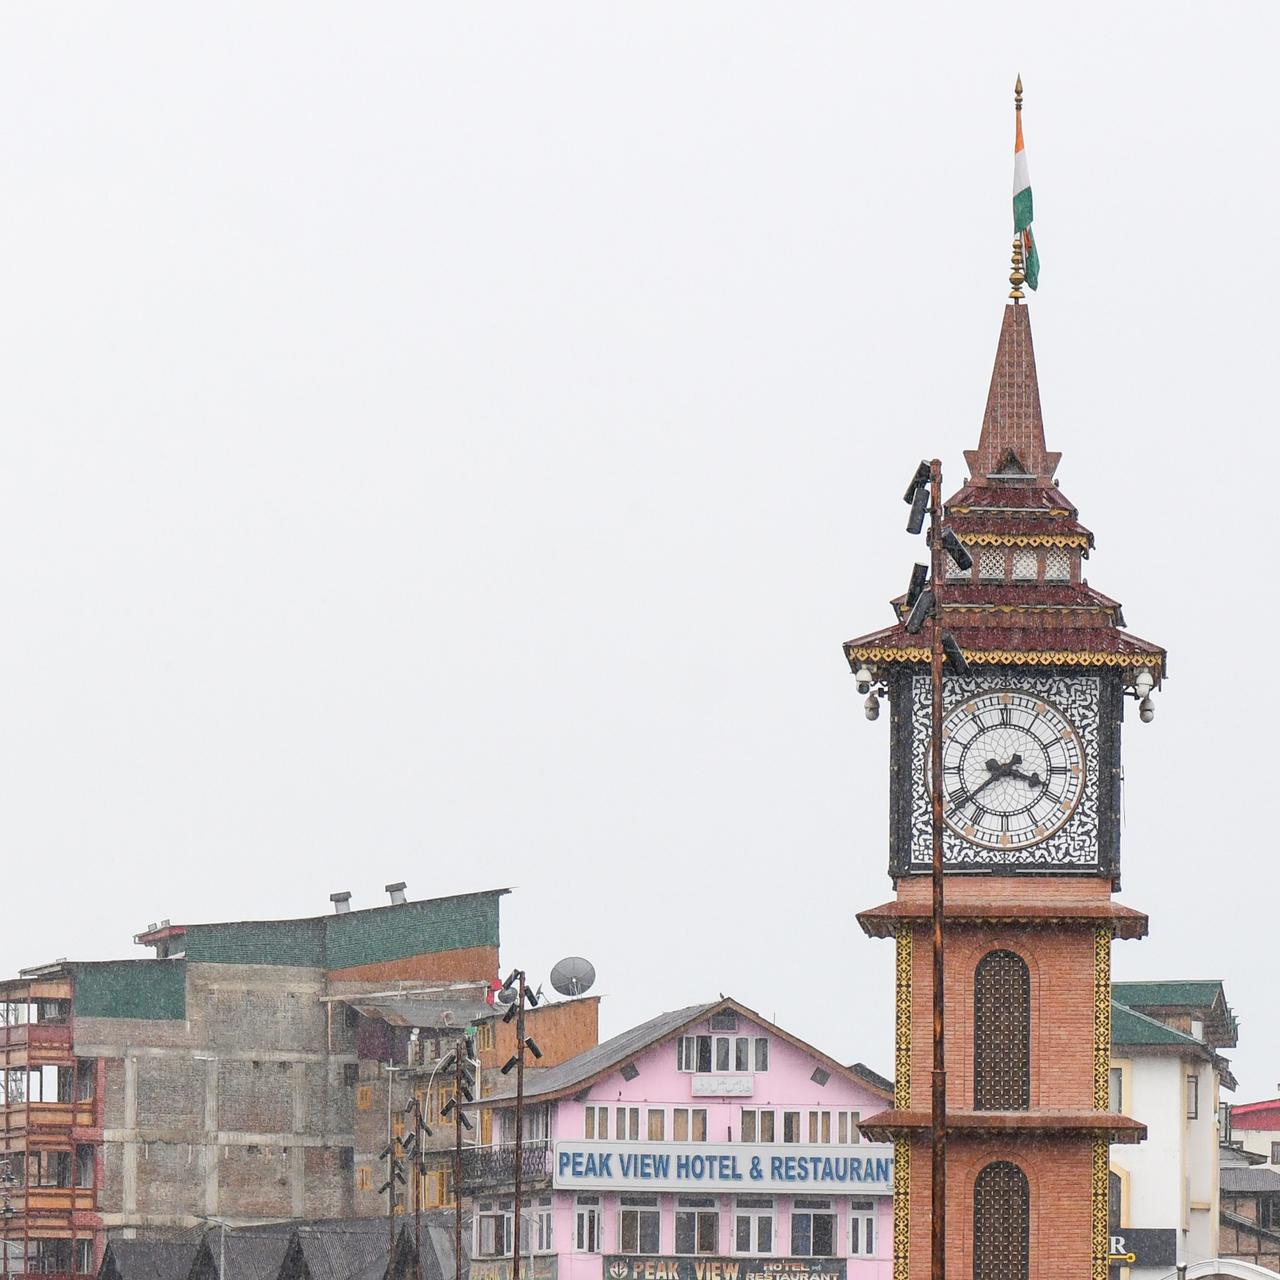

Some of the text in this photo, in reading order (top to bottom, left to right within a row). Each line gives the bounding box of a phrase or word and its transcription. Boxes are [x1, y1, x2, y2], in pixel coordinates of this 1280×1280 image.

[558, 1151, 612, 1179] PEAK
[619, 1152, 670, 1179] VIEW
[676, 1154, 742, 1181] HOTEL
[749, 1155, 763, 1181] &
[763, 1262, 810, 1272] HOTEL
